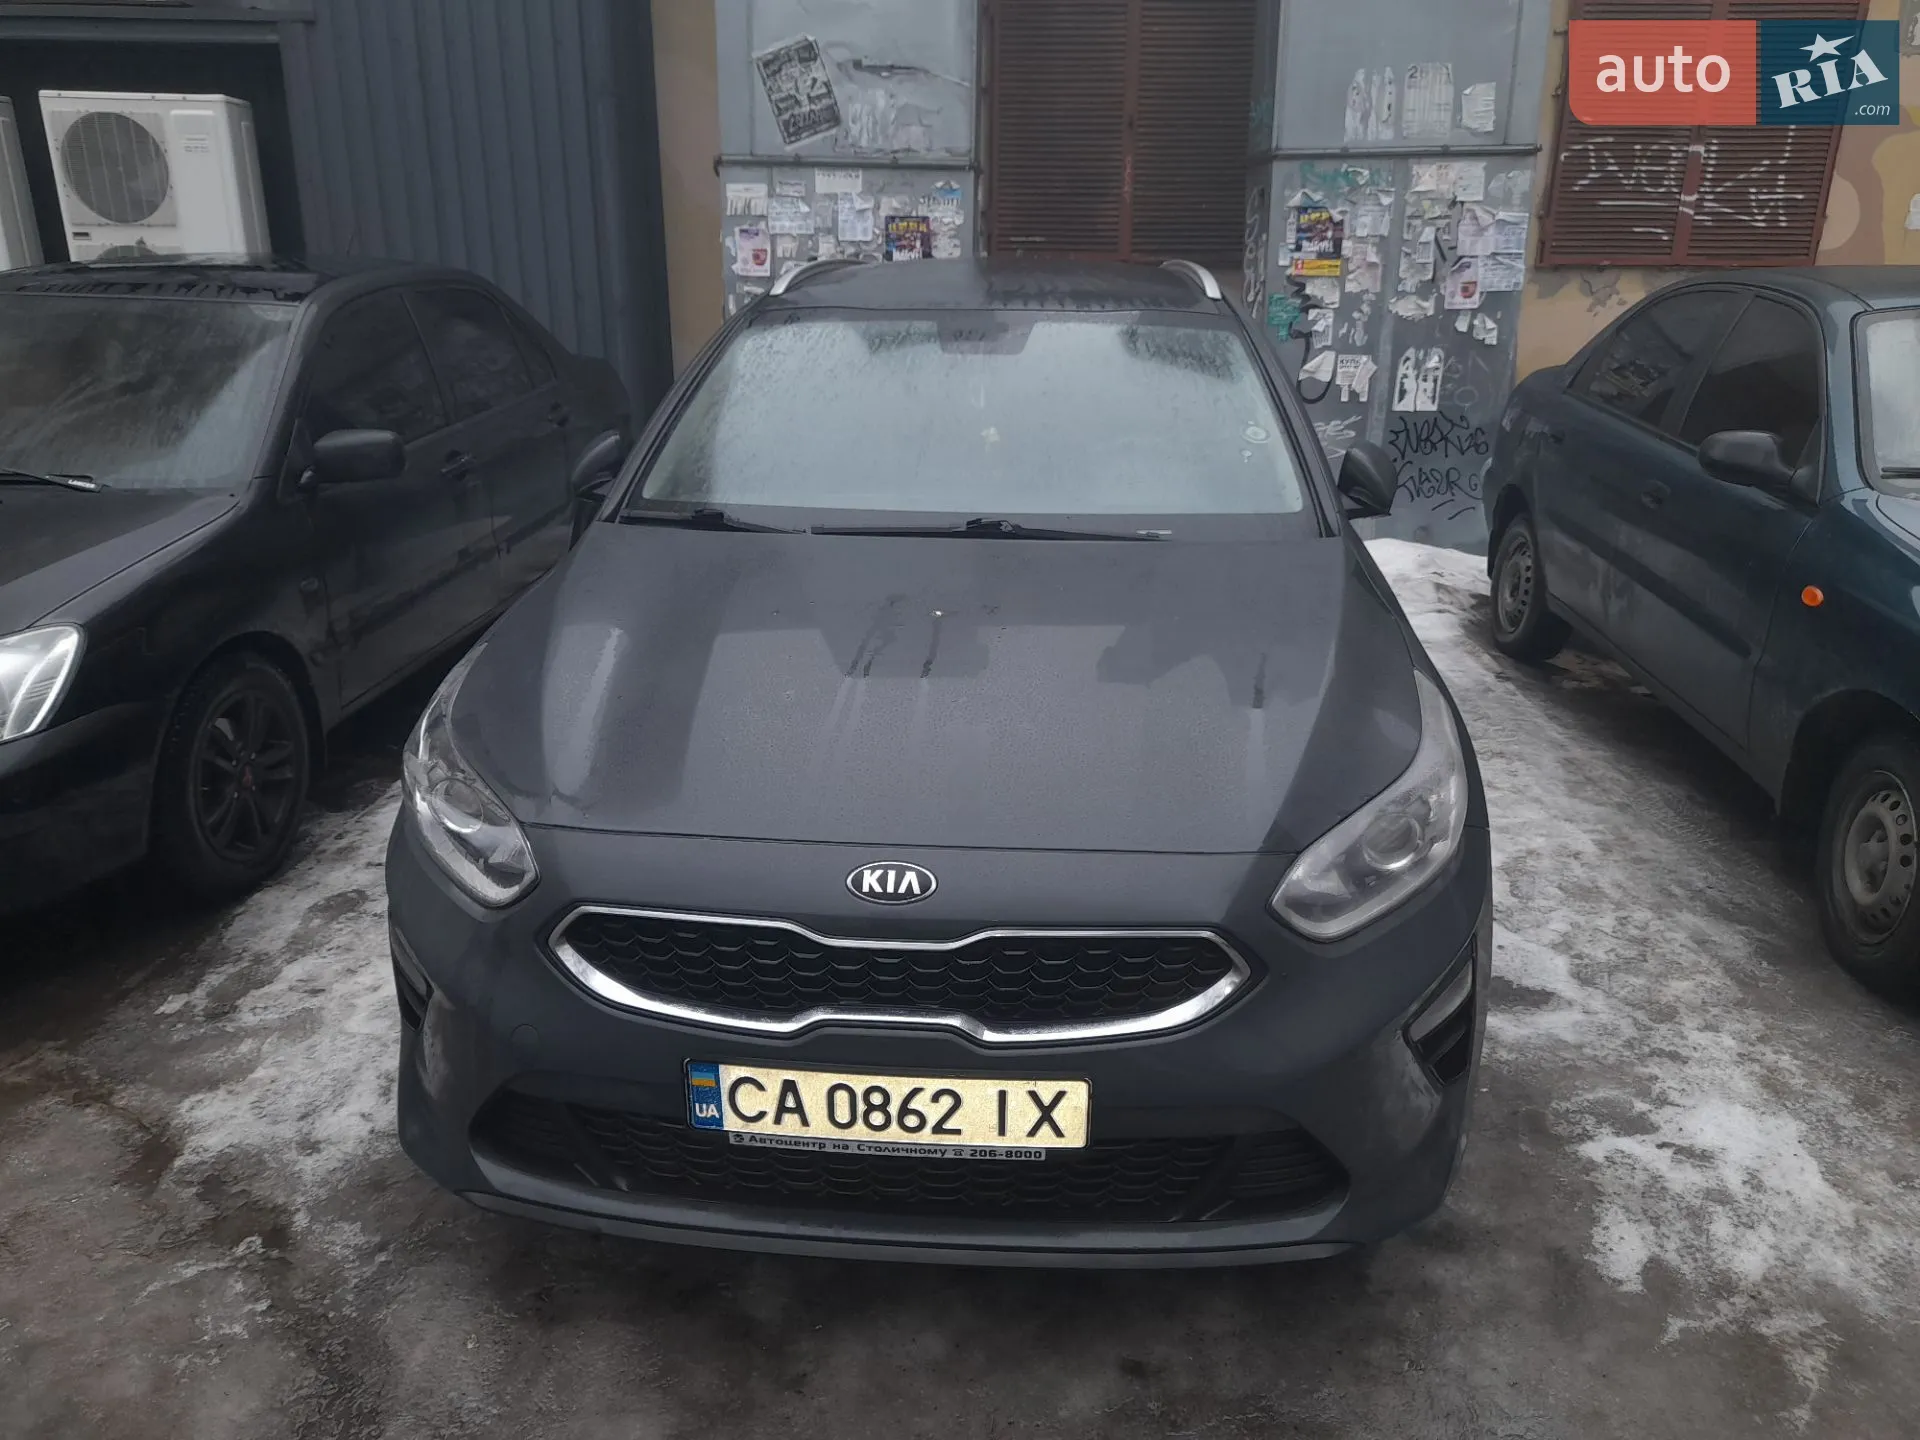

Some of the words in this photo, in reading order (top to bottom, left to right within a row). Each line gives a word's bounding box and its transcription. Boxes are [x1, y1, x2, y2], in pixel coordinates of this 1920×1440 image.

[861, 869, 921, 894] KIA
[694, 1102, 720, 1119] UA
[728, 1075, 810, 1128] CA
[827, 1082, 963, 1136] 0862
[997, 1089, 1068, 1139] IX
[748, 1134, 827, 1151] Автоцентр
[832, 1142, 850, 1151] на
[856, 1143, 948, 1158] Столичному
[969, 1148, 1042, 1160] 206-8000
